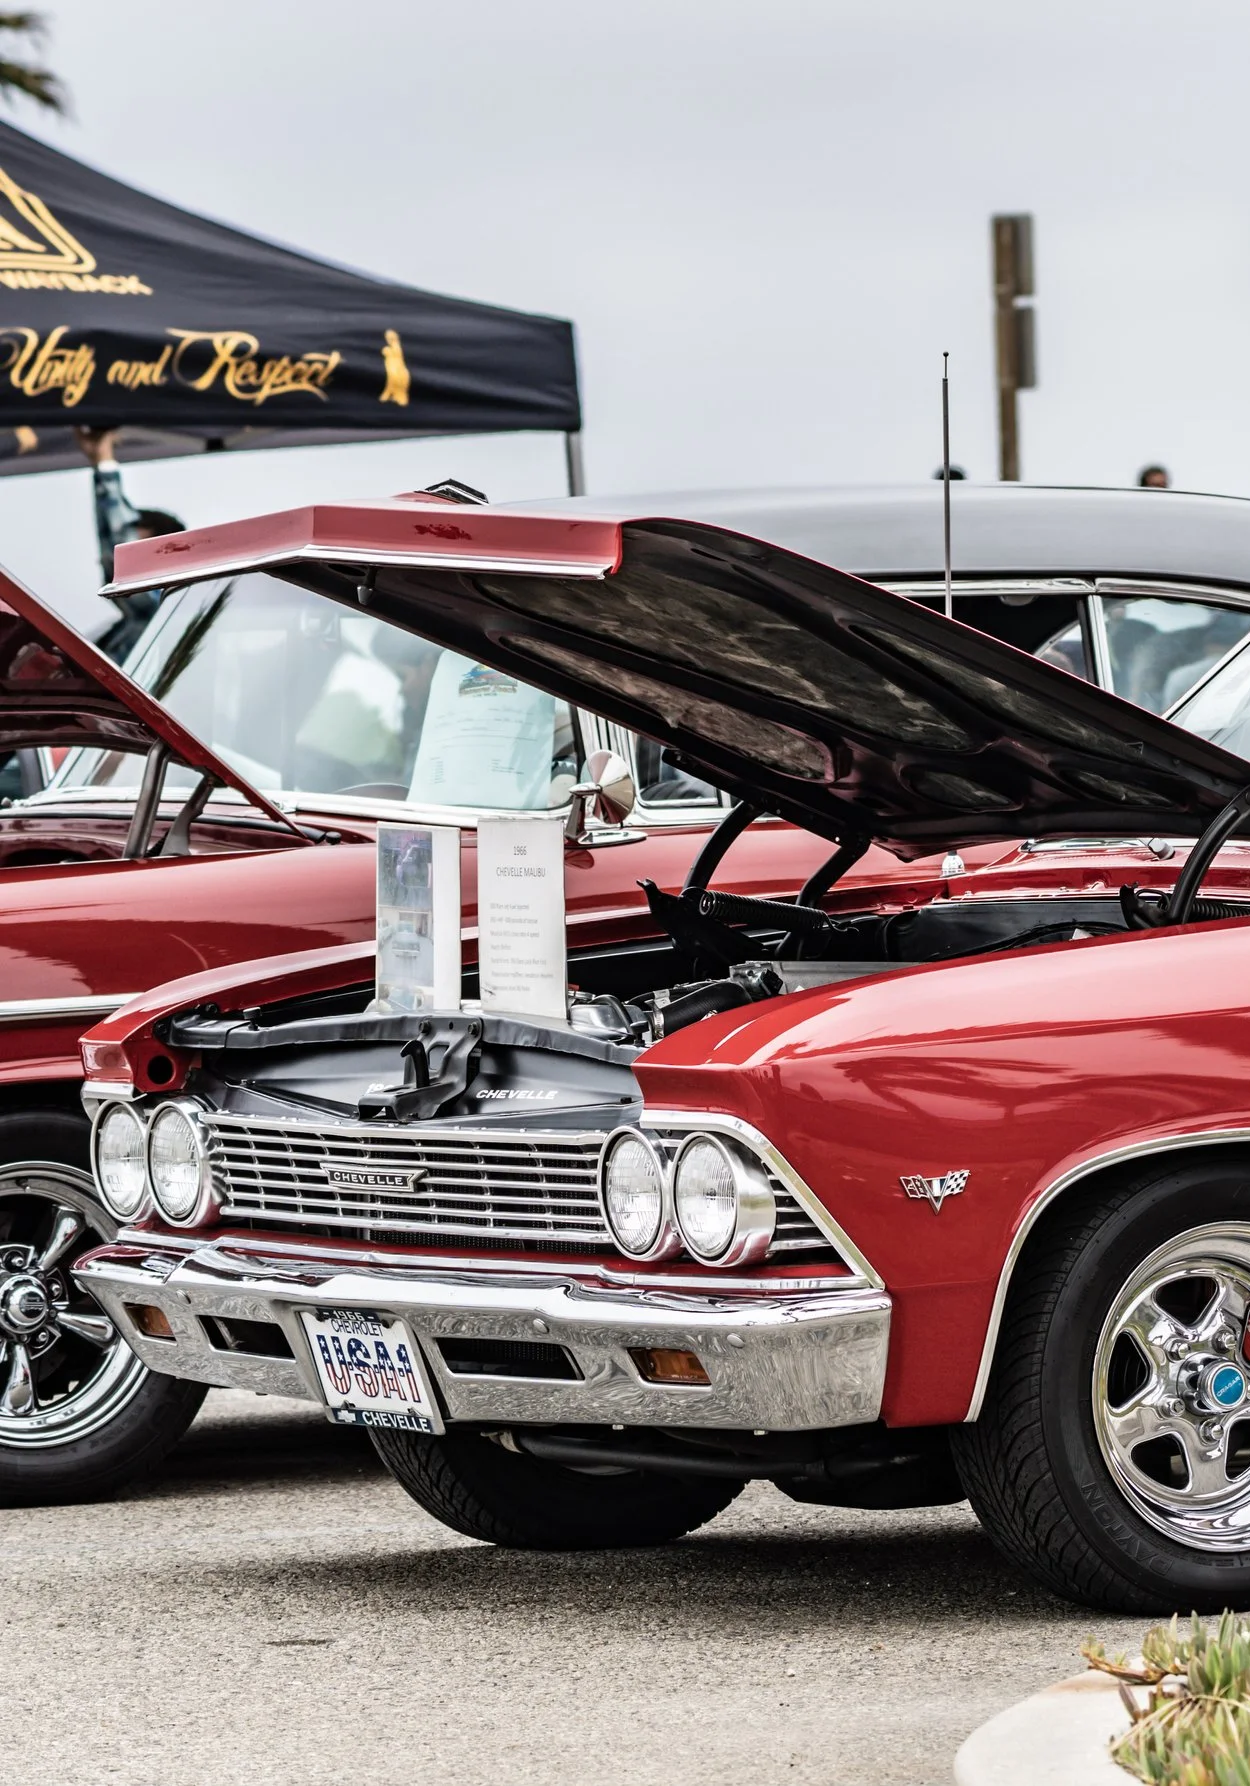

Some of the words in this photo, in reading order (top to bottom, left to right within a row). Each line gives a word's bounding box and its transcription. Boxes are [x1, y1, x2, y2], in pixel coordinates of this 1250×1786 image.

[0, 325, 95, 408] Unity
[106, 344, 172, 390] and
[165, 327, 345, 406] Respect
[513, 845, 527, 856] 1966
[496, 866, 523, 877] CHEVELLE
[475, 1089, 559, 1100] CHEVELLE
[333, 1171, 404, 1186] CHEVELLE
[332, 1310, 365, 1321] 1966
[330, 1318, 384, 1337] CHEVROLET
[361, 1411, 431, 1433] CHEVELLE
